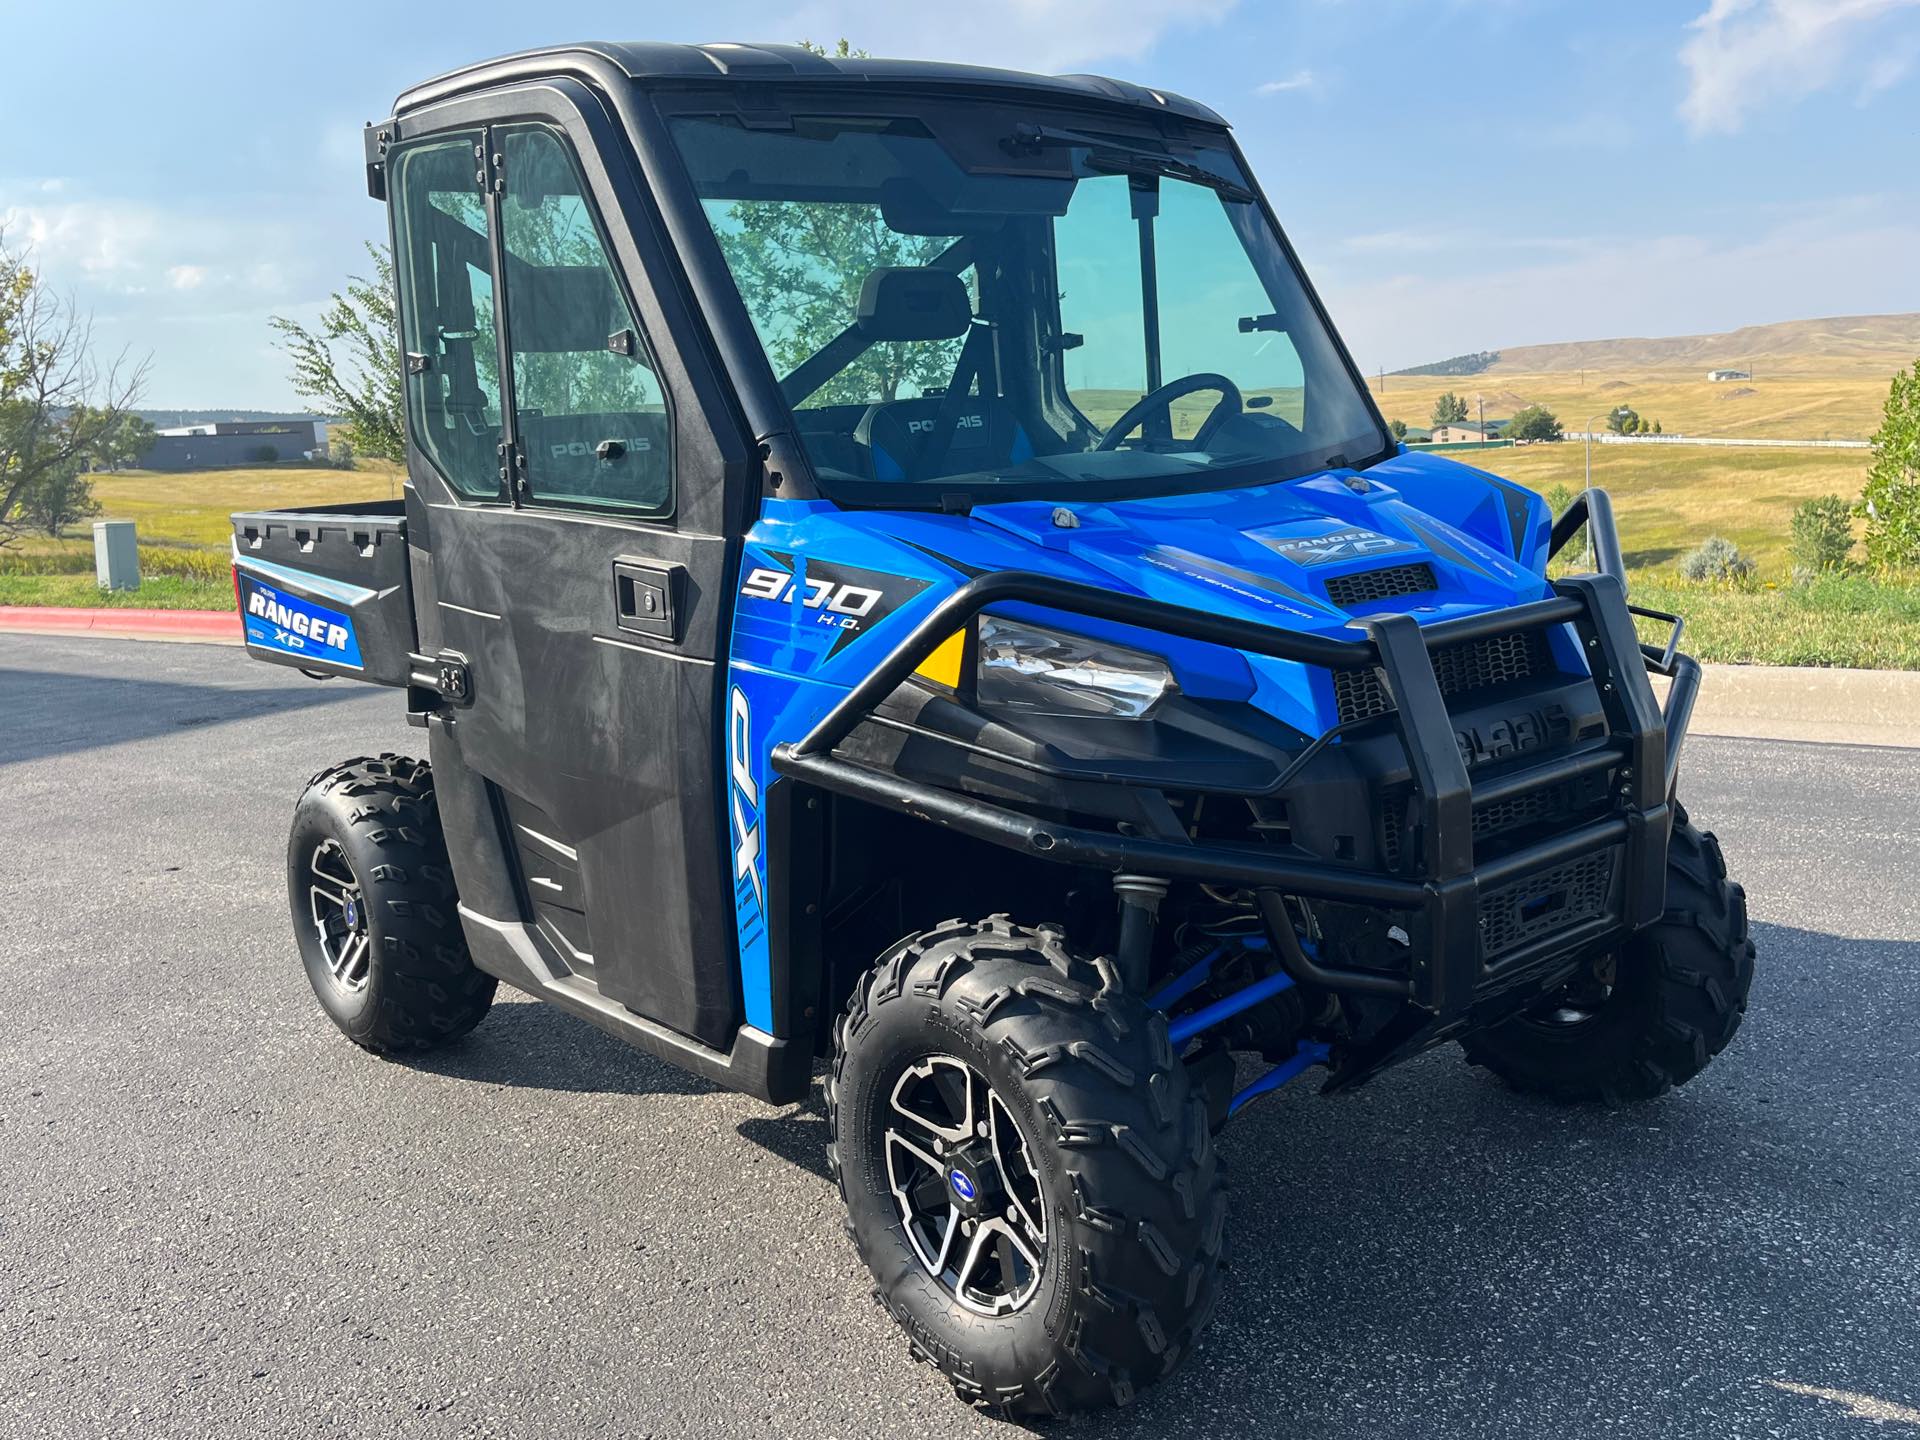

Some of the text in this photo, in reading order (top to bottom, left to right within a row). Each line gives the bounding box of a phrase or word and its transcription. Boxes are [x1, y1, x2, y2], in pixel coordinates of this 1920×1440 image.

[1277, 532, 1376, 551] RANGER
[1301, 539, 1395, 567] XP
[741, 568, 883, 617] 900
[1137, 553, 1314, 620] DUAL OVERHEAD CAM
[249, 592, 349, 651] RANGER
[273, 628, 304, 648] XP
[817, 613, 861, 631] H.O.
[731, 685, 766, 923] XP
